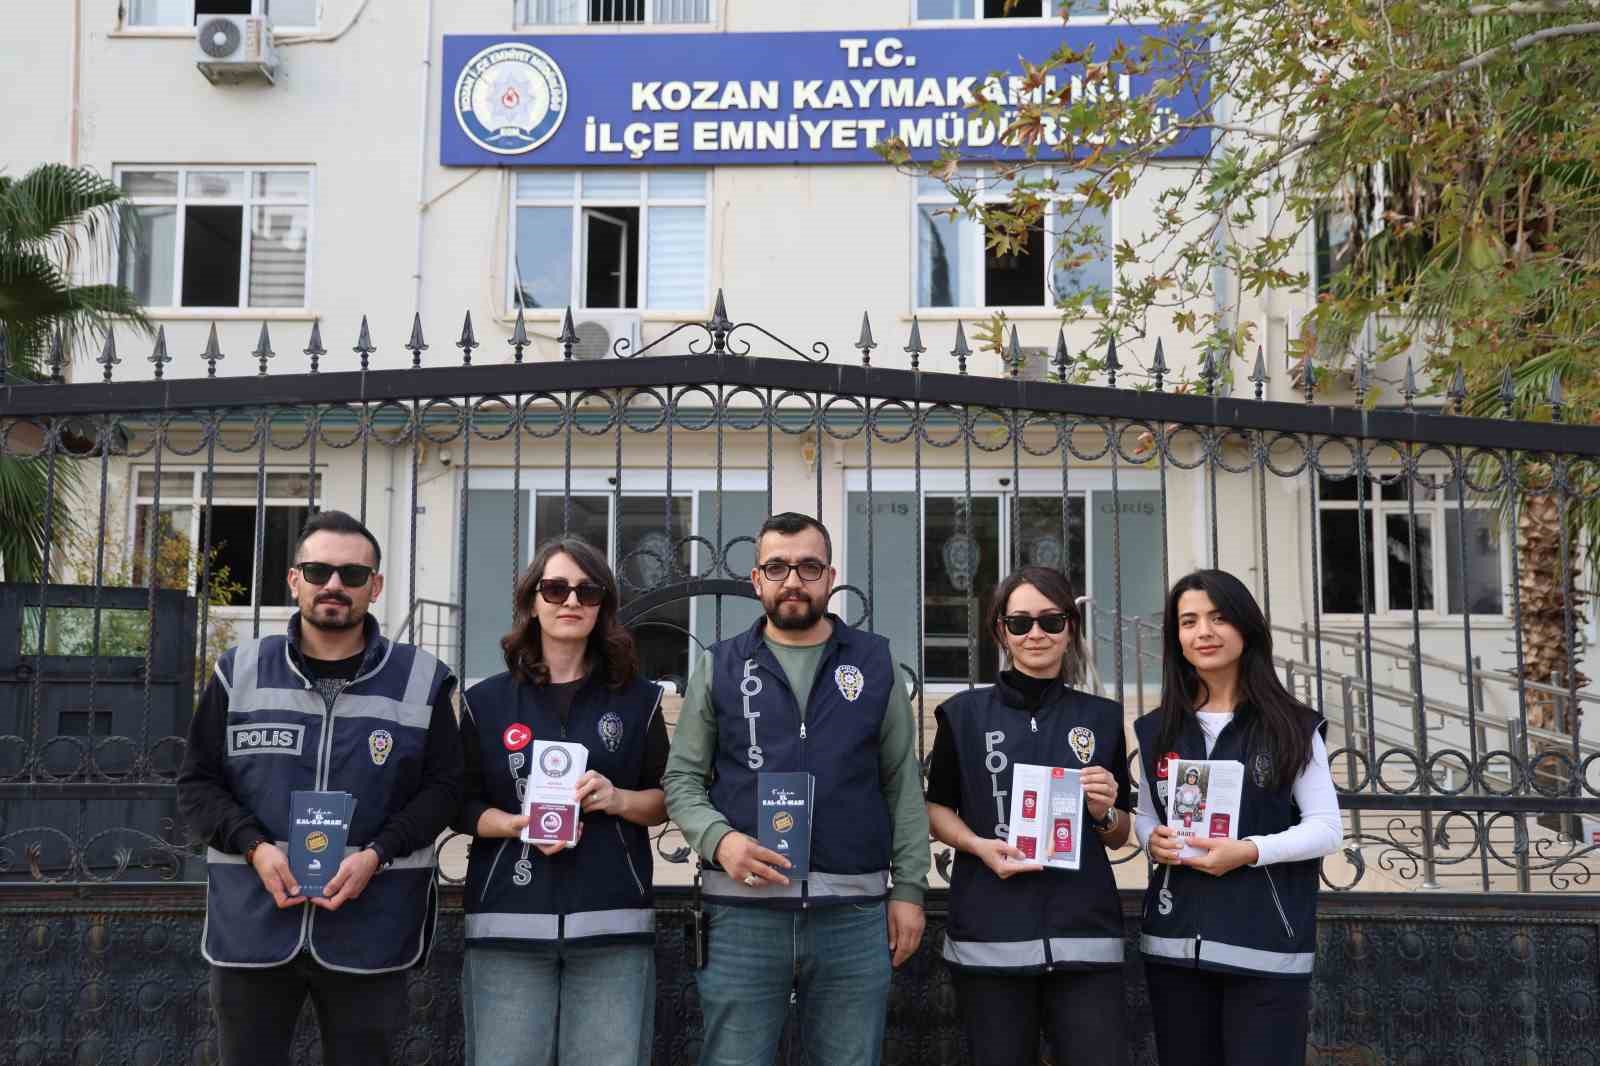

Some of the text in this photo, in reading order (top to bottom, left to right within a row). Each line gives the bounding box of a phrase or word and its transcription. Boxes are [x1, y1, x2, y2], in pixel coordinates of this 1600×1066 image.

[839, 38, 917, 69] T.C.
[631, 80, 779, 112] KOZAN
[584, 115, 680, 159] İLÇE
[693, 112, 888, 152] EMNİYET
